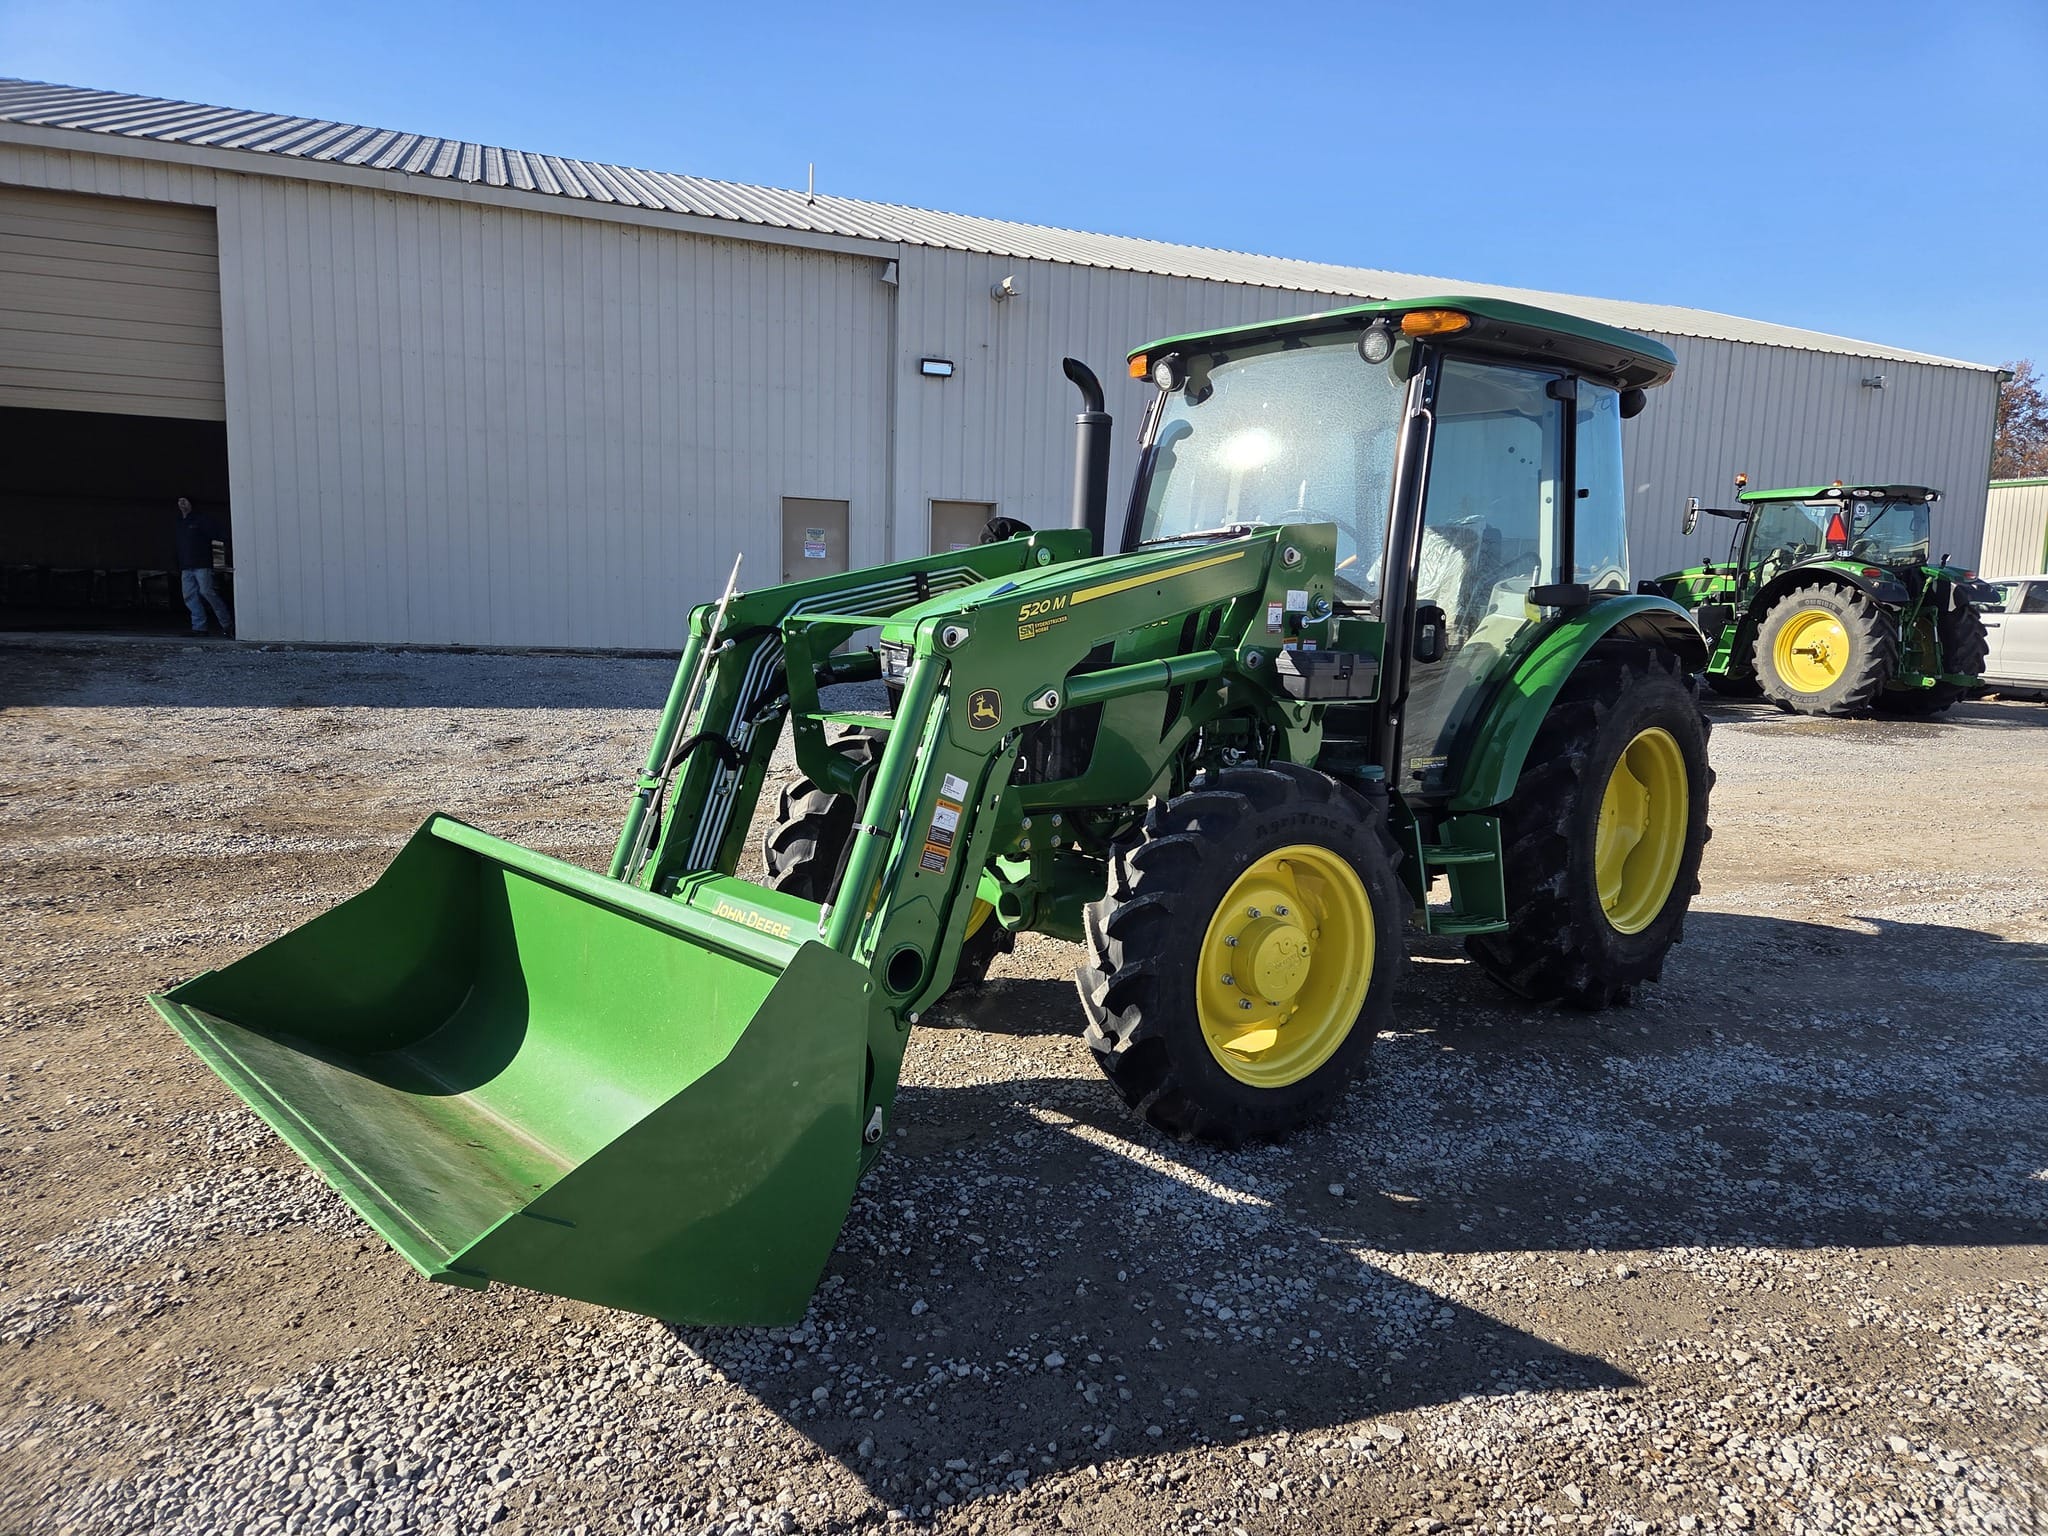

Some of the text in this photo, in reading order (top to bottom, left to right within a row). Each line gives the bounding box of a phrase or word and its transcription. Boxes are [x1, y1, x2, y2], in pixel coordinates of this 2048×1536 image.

[1018, 595, 1067, 621] 520 M
[713, 900, 792, 939] JOHN DEERE
